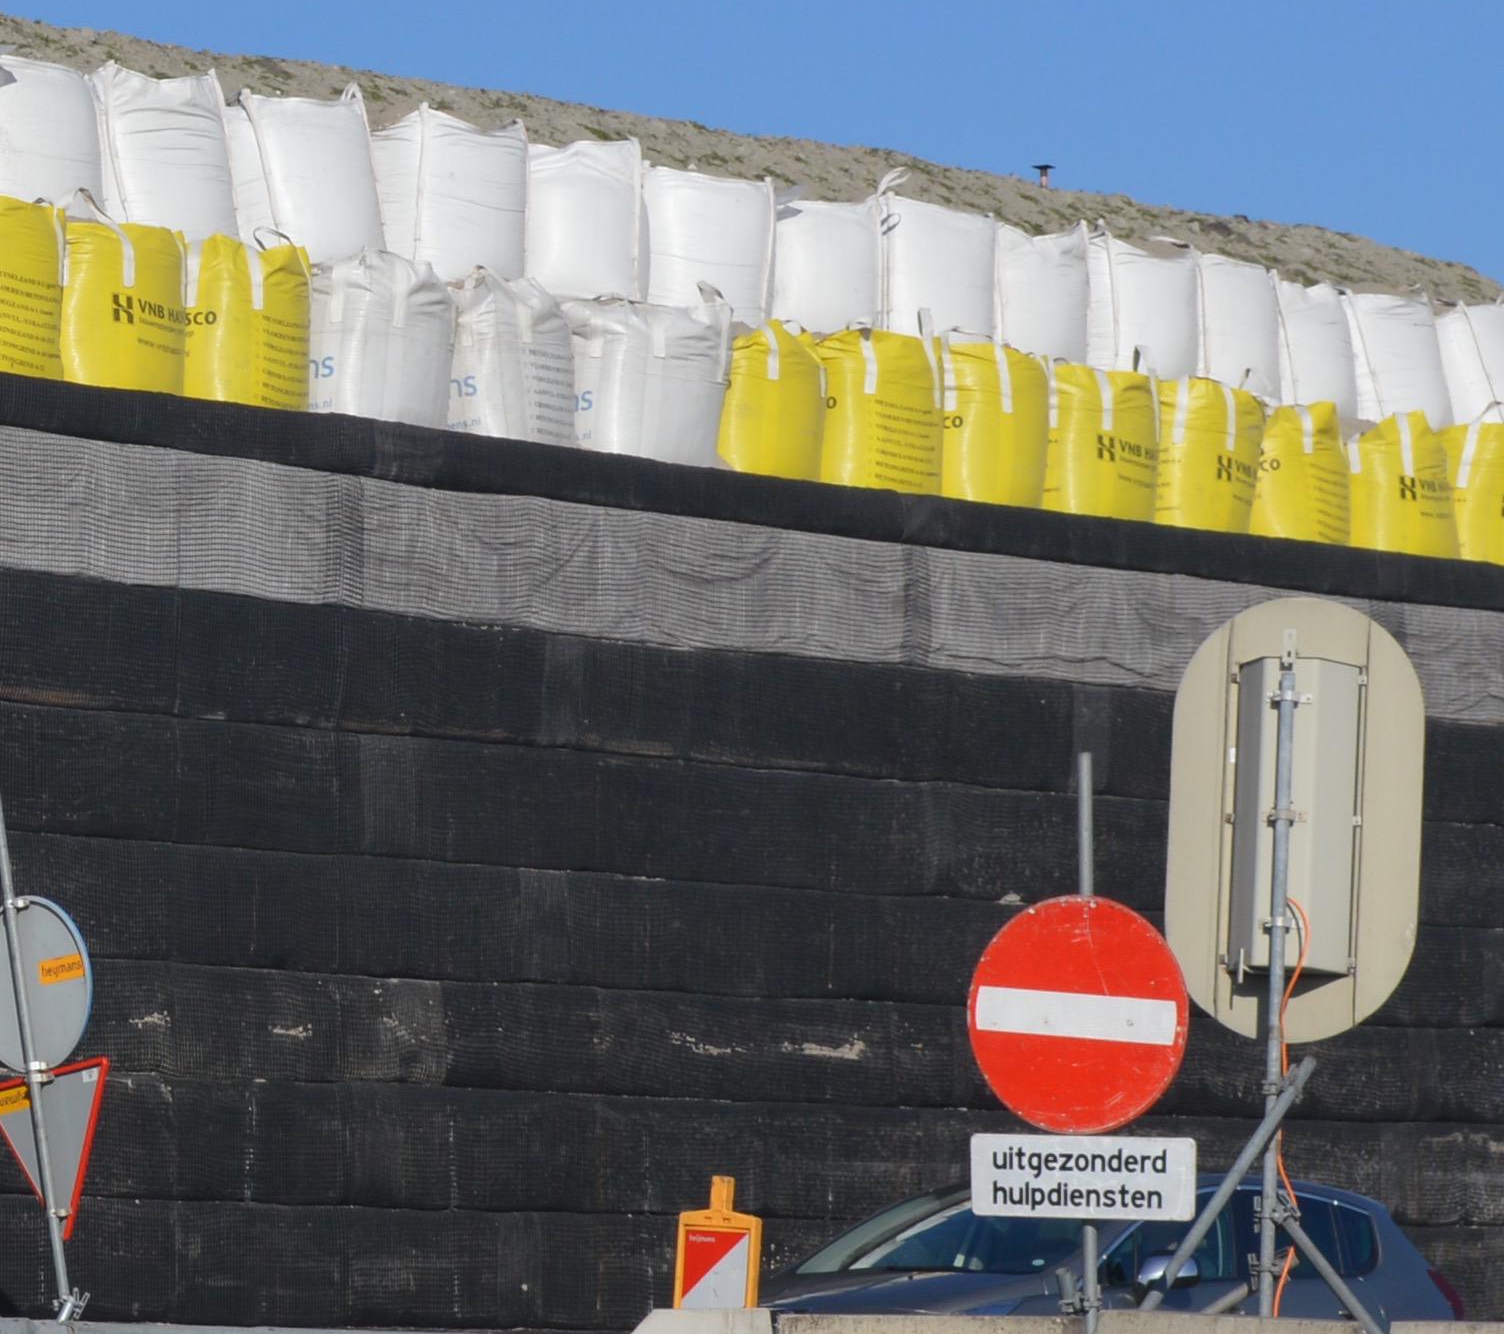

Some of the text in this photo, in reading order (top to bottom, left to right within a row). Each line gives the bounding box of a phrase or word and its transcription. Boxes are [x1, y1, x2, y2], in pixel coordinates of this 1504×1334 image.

[138, 298, 165, 319] VNB
[992, 1146, 1167, 1179] uitgezonderd
[992, 1180, 1163, 1210] hulpdiensten
